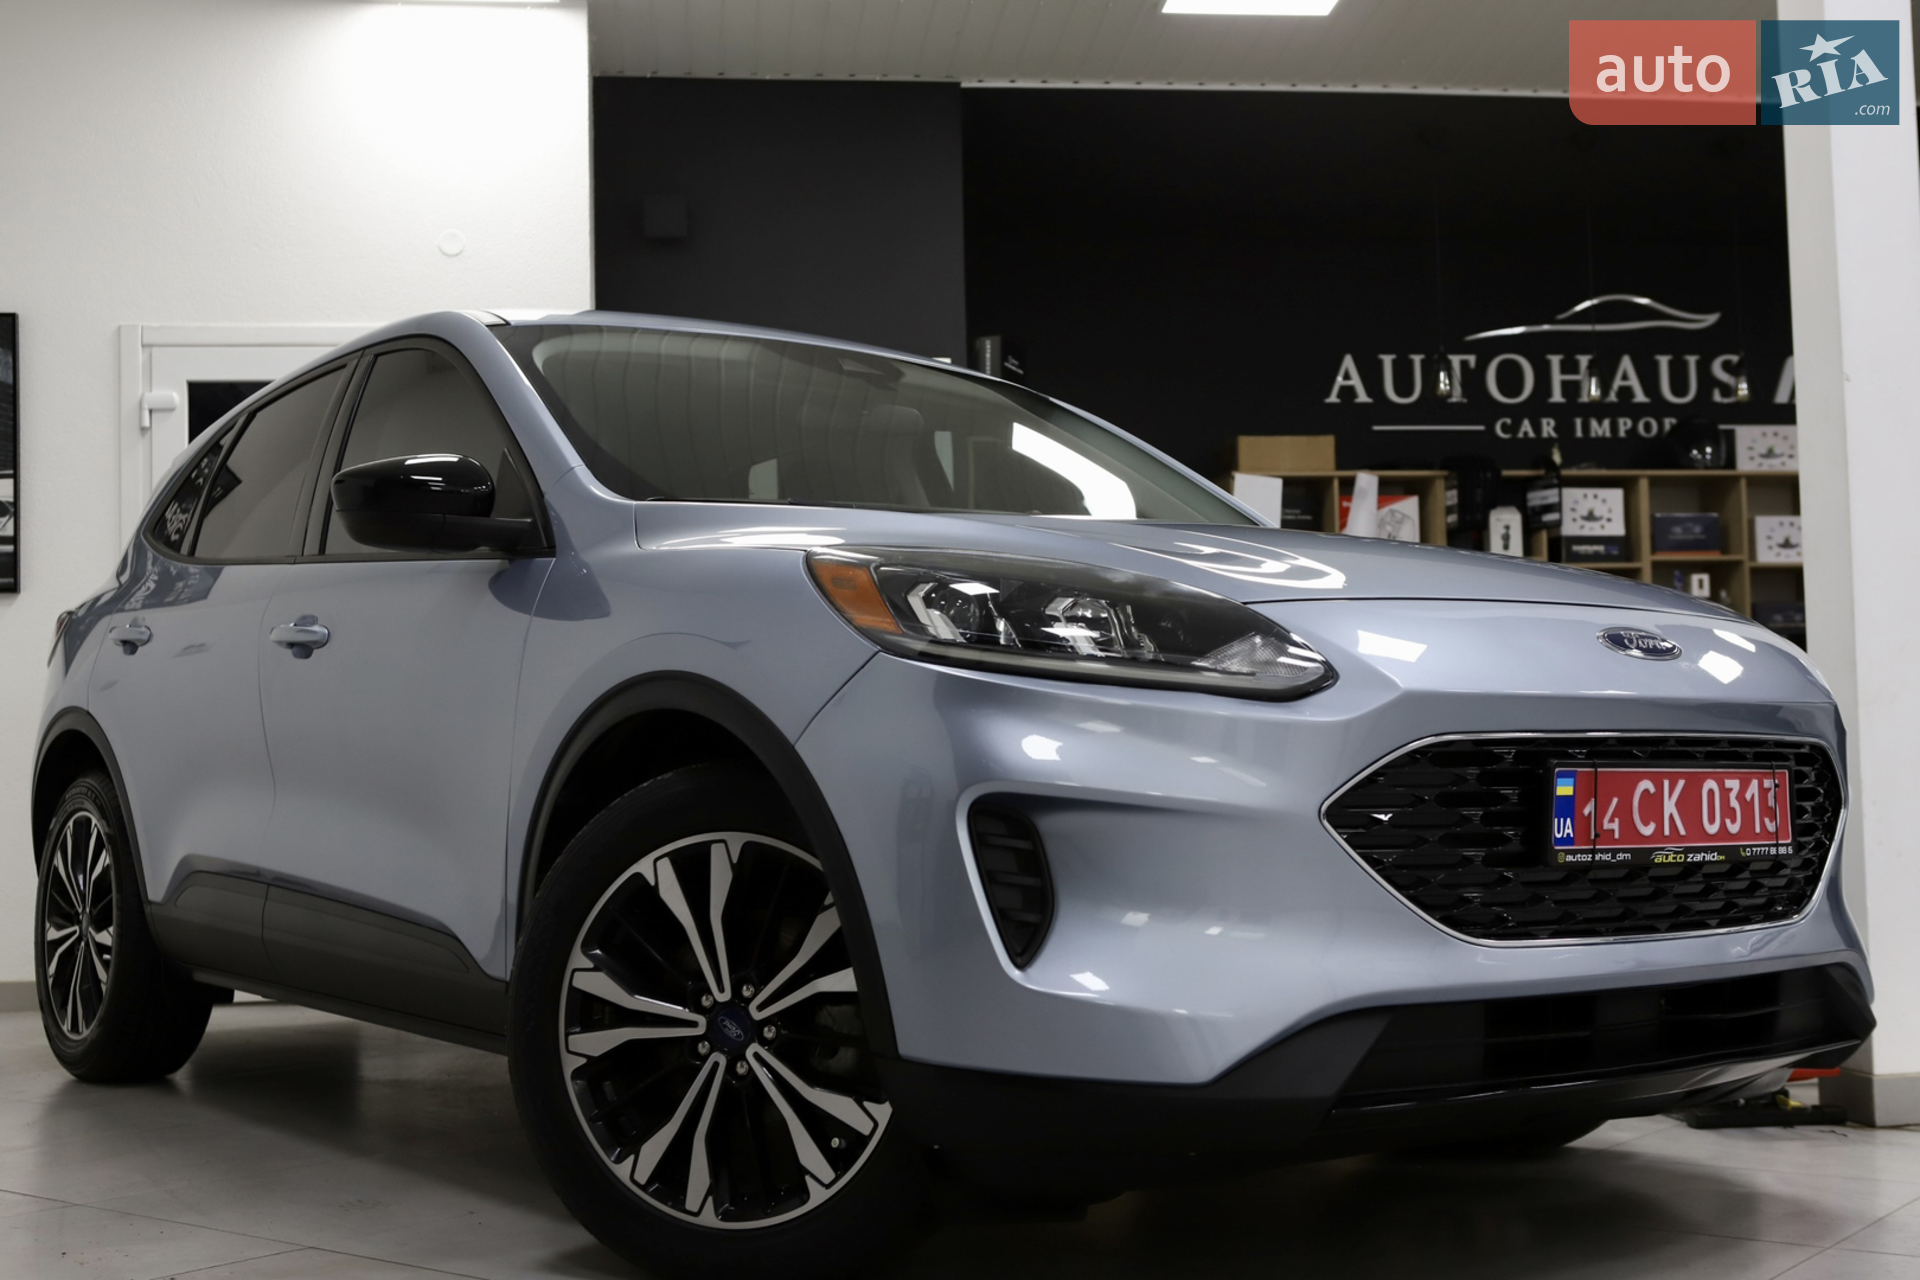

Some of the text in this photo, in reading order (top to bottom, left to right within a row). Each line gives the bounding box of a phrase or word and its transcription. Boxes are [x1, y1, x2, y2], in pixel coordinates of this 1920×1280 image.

[1324, 353, 1744, 405] AUTOHAUS
[1495, 417, 1559, 439] CAR
[1620, 631, 1668, 651] Ford
[1582, 779, 1781, 840] 14 CK 0313
[1554, 817, 1574, 838] UA
